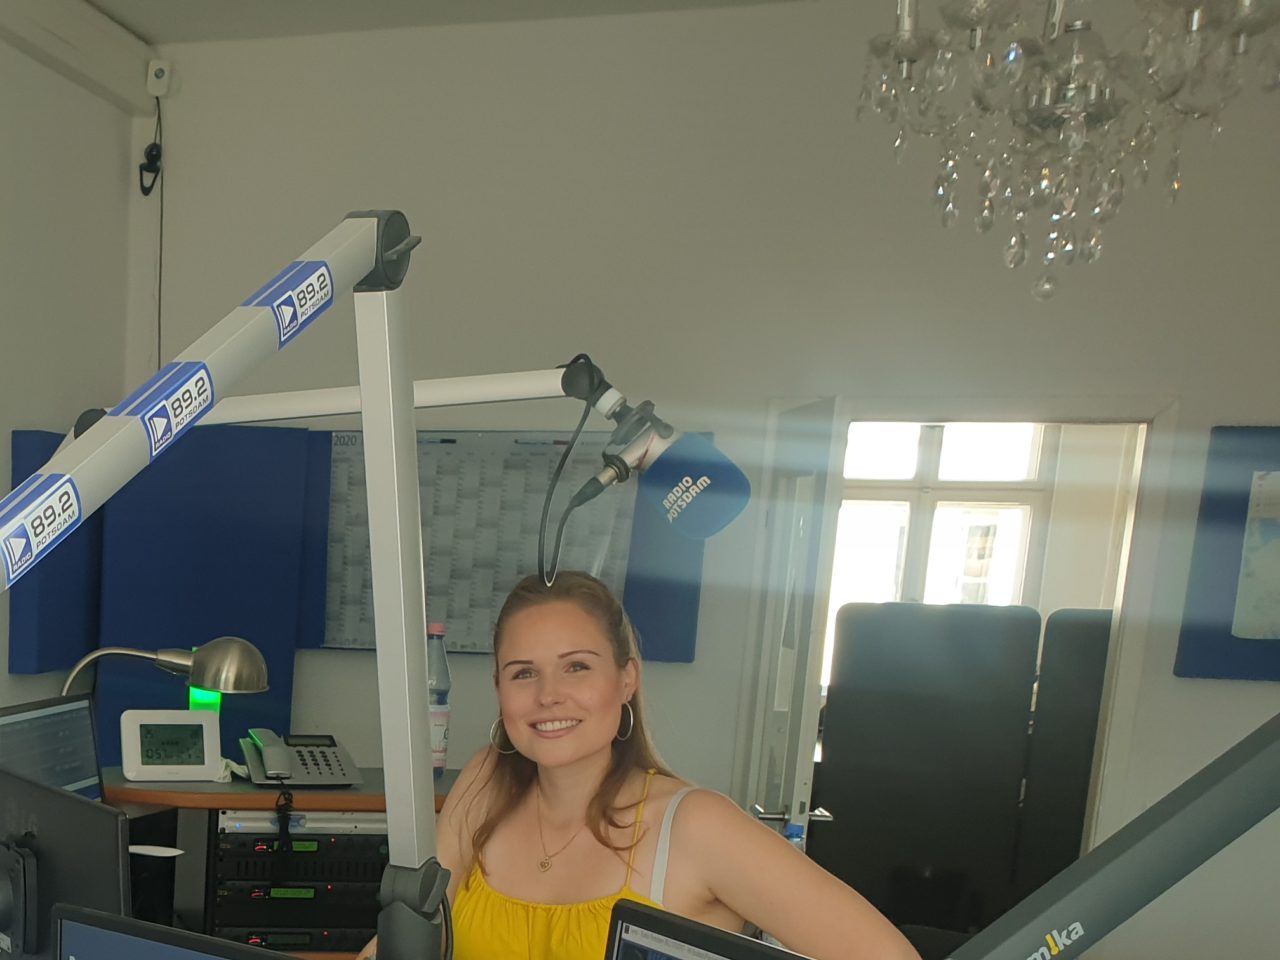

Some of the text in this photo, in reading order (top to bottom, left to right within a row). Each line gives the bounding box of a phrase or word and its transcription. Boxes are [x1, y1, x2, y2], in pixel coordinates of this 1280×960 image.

[296, 272, 328, 309] 89.2
[300, 290, 330, 318] POTSDAM
[171, 376, 207, 420] 89.2
[175, 395, 210, 430] POTSDAM
[155, 431, 172, 449] RADIO
[333, 435, 357, 446] 2020
[662, 476, 693, 510] RADIO
[30, 490, 74, 538] 89.2
[36, 510, 76, 550] POTSDAM
[12, 553, 32, 572] RADIO
